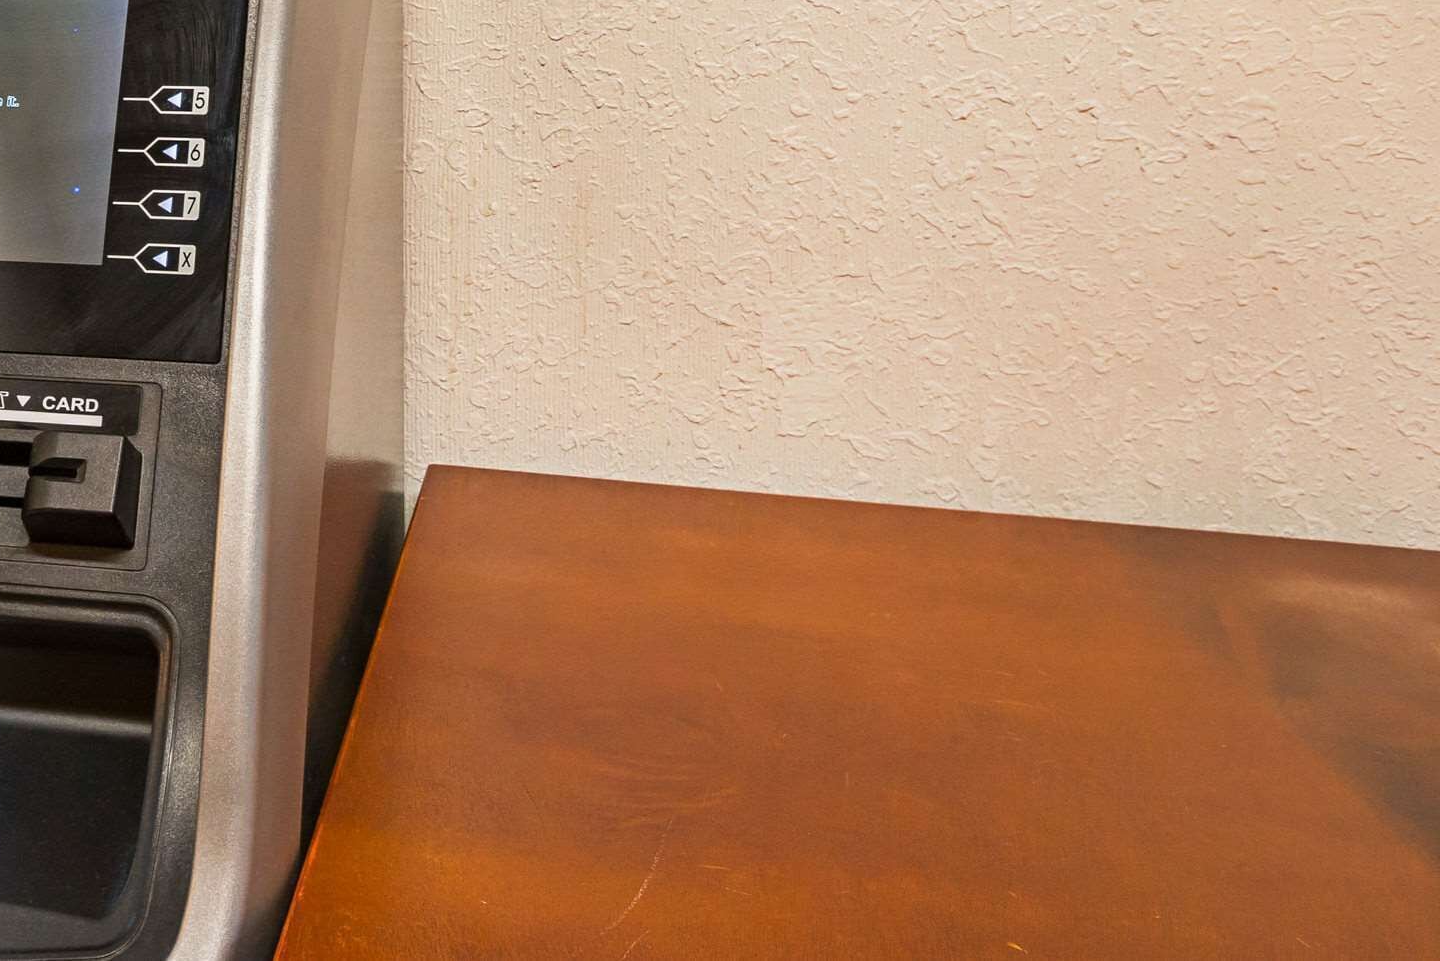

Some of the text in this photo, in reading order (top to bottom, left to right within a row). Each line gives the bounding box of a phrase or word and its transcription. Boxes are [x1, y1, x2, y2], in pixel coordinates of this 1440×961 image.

[7, 95, 20, 108] it.
[194, 92, 205, 109] 5
[190, 144, 201, 161] 6
[186, 197, 197, 215] 7
[182, 252, 191, 267] X
[42, 395, 99, 413] CARD
